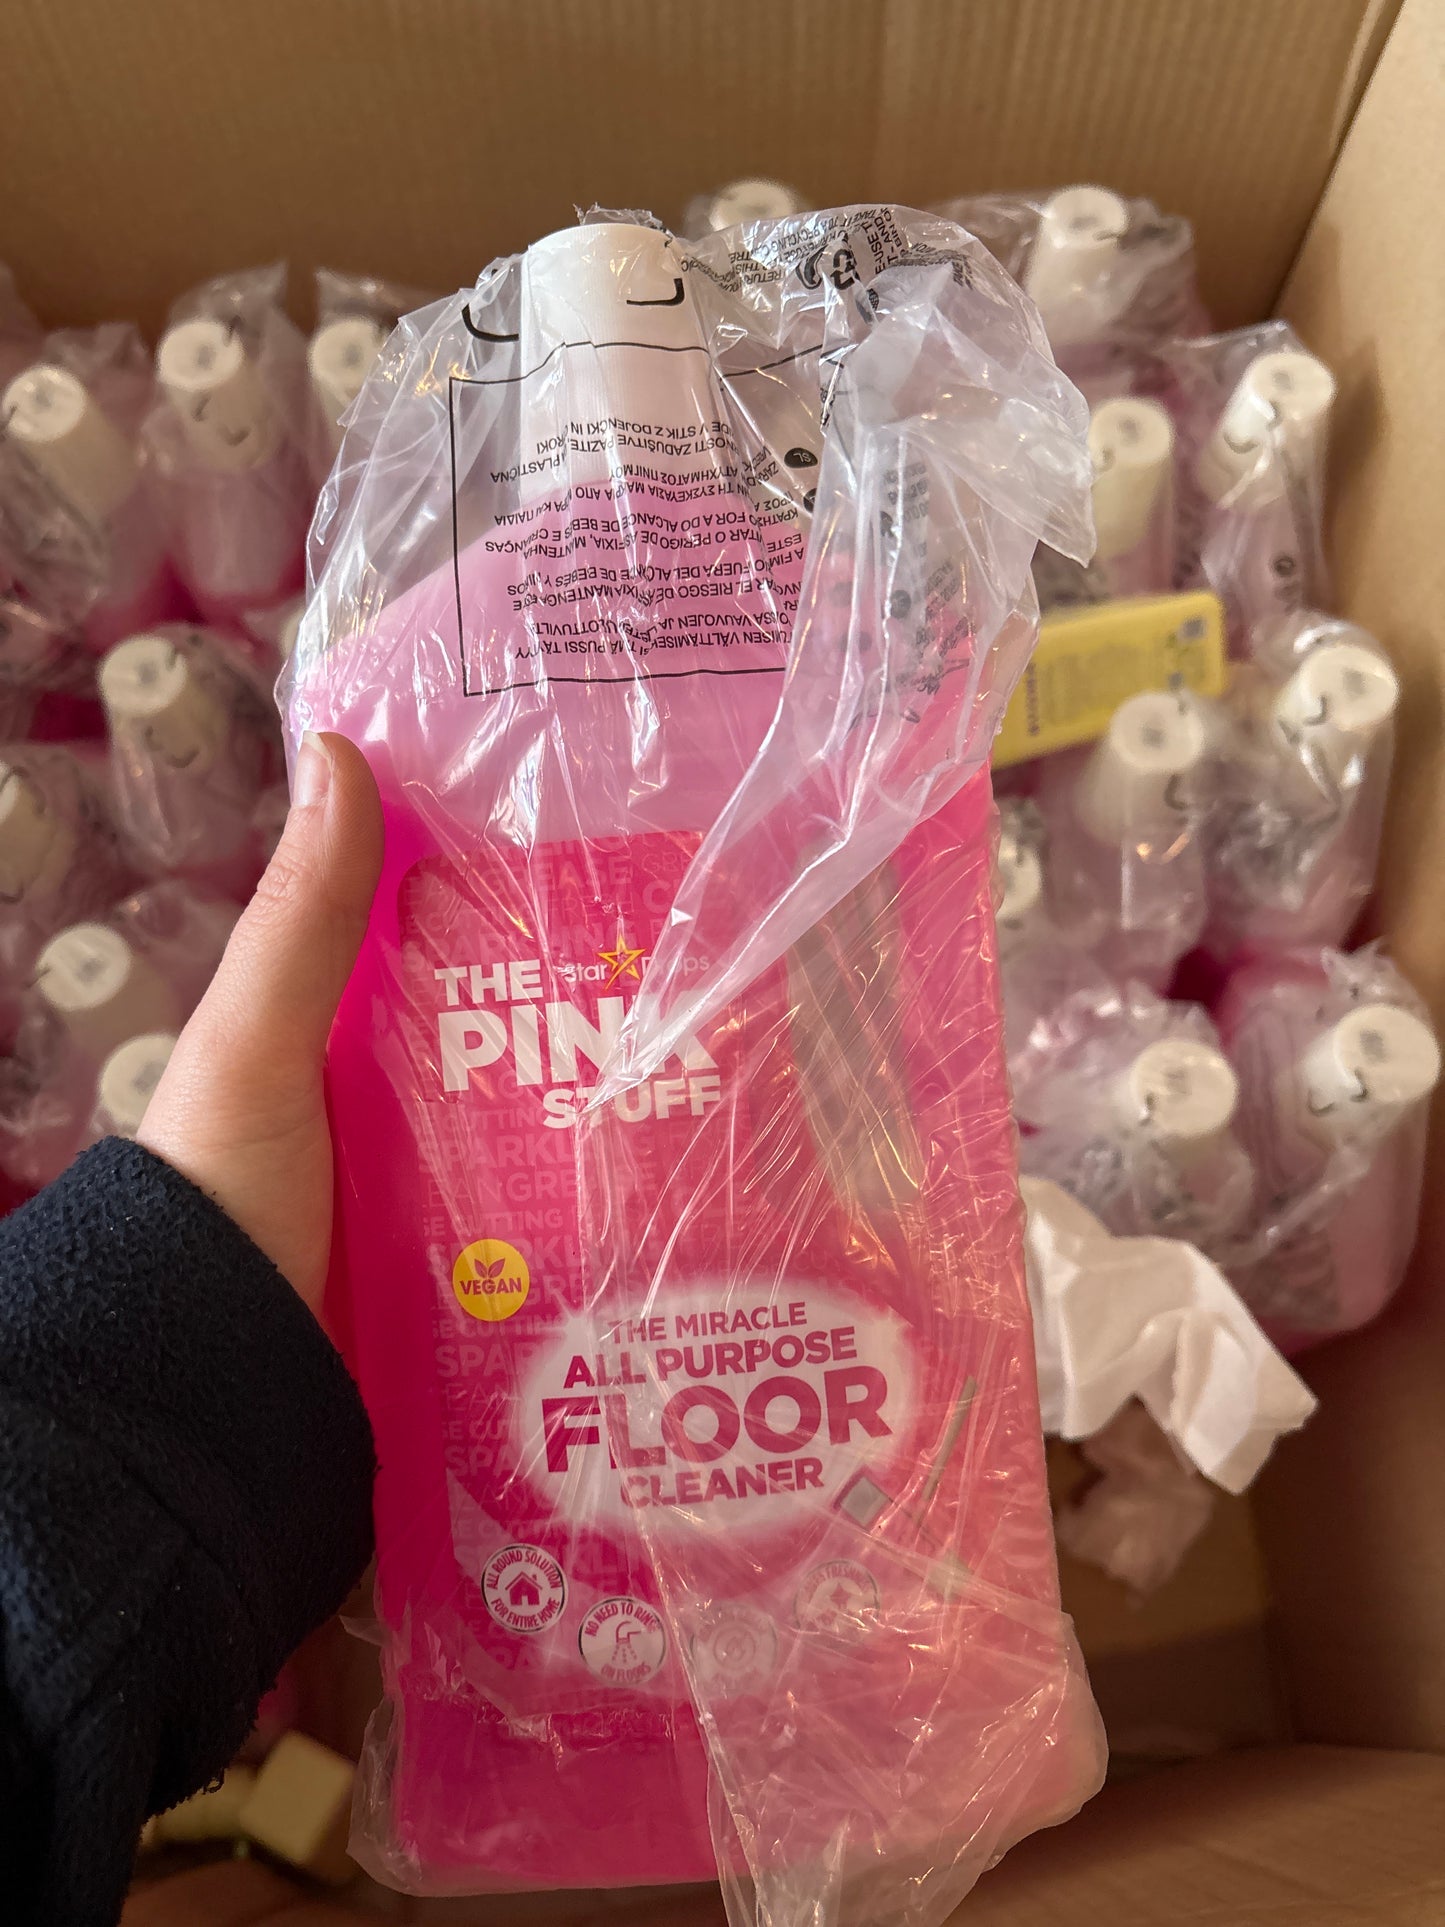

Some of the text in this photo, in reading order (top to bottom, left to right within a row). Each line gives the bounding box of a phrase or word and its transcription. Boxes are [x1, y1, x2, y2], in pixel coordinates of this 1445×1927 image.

[601, 519, 620, 533] DE
[681, 517, 700, 532] DO
[641, 531, 658, 545] DE
[660, 533, 711, 550] PERIGO
[715, 531, 726, 542] O
[767, 534, 802, 553] ESTE
[599, 568, 616, 582] DE
[673, 566, 701, 580] DEL
[678, 582, 733, 599] RIESGO
[657, 618, 675, 630] JA
[679, 614, 752, 628] VAUVOJEN
[564, 640, 606, 654] PUSSI
[435, 959, 544, 1006] THE
[437, 990, 719, 1093] PINK
[543, 1075, 721, 1129] STUFF
[459, 1277, 523, 1296] VEGAN
[607, 1301, 808, 1345] THE MIRACLE
[563, 1325, 858, 1389] ALL PURPOSE
[541, 1365, 893, 1473] FLOOR
[620, 1456, 825, 1509] CLEANER
[486, 1550, 561, 1590] ALL ROUND SOLUTION
[490, 1597, 560, 1629] FOR ENTIRE HOME
[584, 1622, 599, 1637] NO
[593, 1602, 619, 1624] NEED
[621, 1601, 633, 1616] TO
